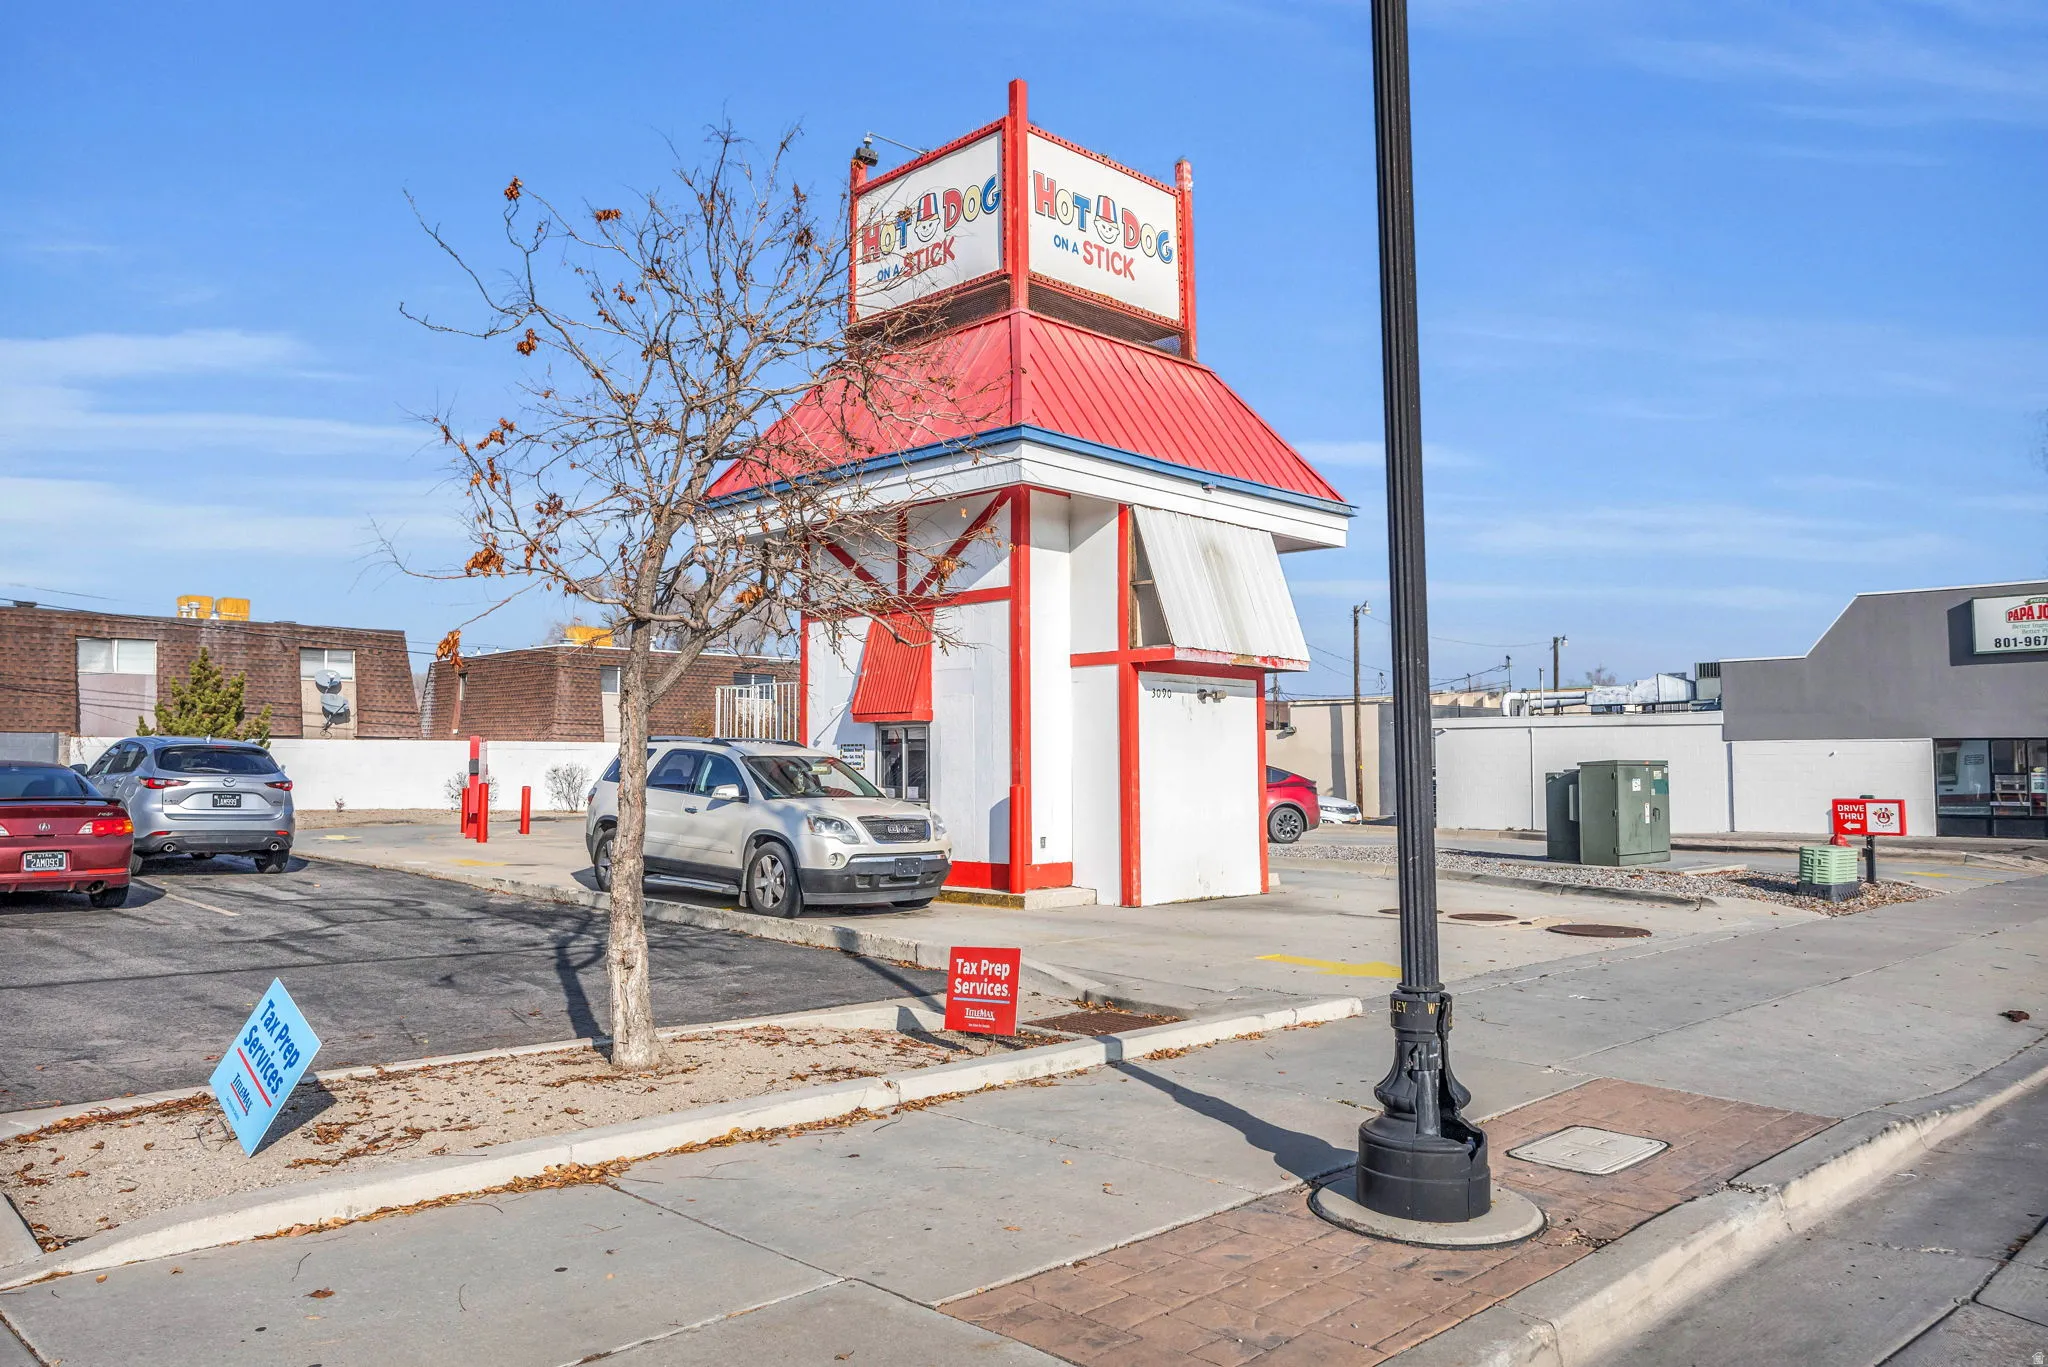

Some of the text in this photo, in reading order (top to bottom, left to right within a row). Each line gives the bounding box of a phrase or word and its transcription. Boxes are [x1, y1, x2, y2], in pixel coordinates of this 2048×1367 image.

[862, 173, 1001, 263] HOT DOG
[1033, 170, 1173, 264] HOT DOG
[877, 236, 955, 282] ON A STICK
[1053, 235, 1135, 281] ON A STICK
[2007, 605, 2035, 621] PAPA
[1152, 688, 1172, 698] 3090
[1837, 804, 1864, 812] DRIVE
[956, 958, 1010, 980] Tax Prep
[954, 977, 1010, 997] Services.
[260, 998, 300, 1070] Tax Prep
